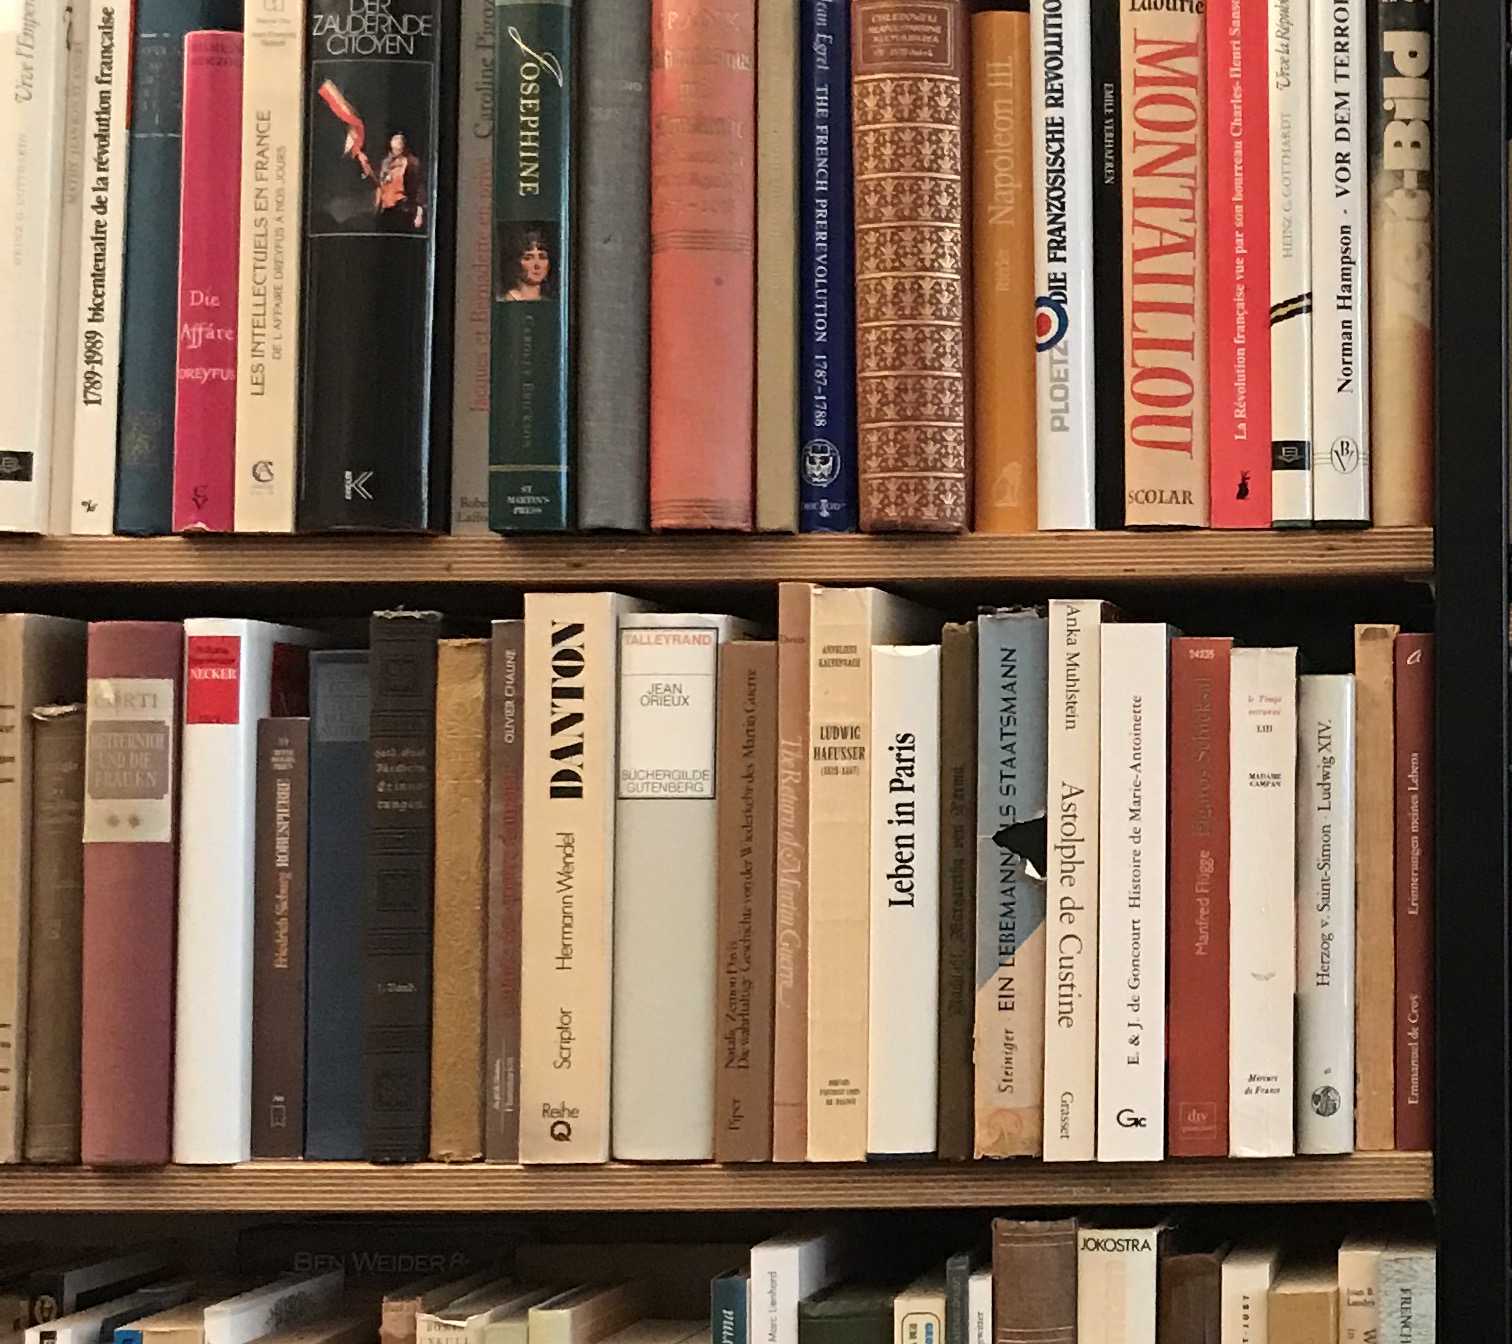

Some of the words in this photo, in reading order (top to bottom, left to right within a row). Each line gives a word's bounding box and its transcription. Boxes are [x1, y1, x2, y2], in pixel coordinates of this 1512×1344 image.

[253, 110, 271, 181] FRANCE
[1335, 92, 1351, 143] DEM
[253, 187, 269, 211] EN
[1335, 152, 1352, 198] VOR
[1129, 27, 1200, 459] MONTAILLOU
[1336, 225, 1354, 311] Hampson
[250, 218, 269, 358] INTELLECTUELS
[250, 364, 266, 396] LES
[1336, 319, 1354, 394] Norman
[624, 634, 712, 647] TALLEYRAND
[550, 619, 586, 800] DANTON
[889, 733, 917, 794] Paris
[888, 801, 915, 826] in
[1059, 782, 1083, 887] Astolphe
[555, 832, 575, 893] Wendel
[887, 835, 916, 907] Leben
[555, 895, 575, 970] Hermann
[1057, 896, 1084, 925] de
[1056, 933, 1082, 1029] Custine
[554, 1007, 575, 1070] Scriptor
[1082, 1237, 1151, 1252] JOKOSTRA
